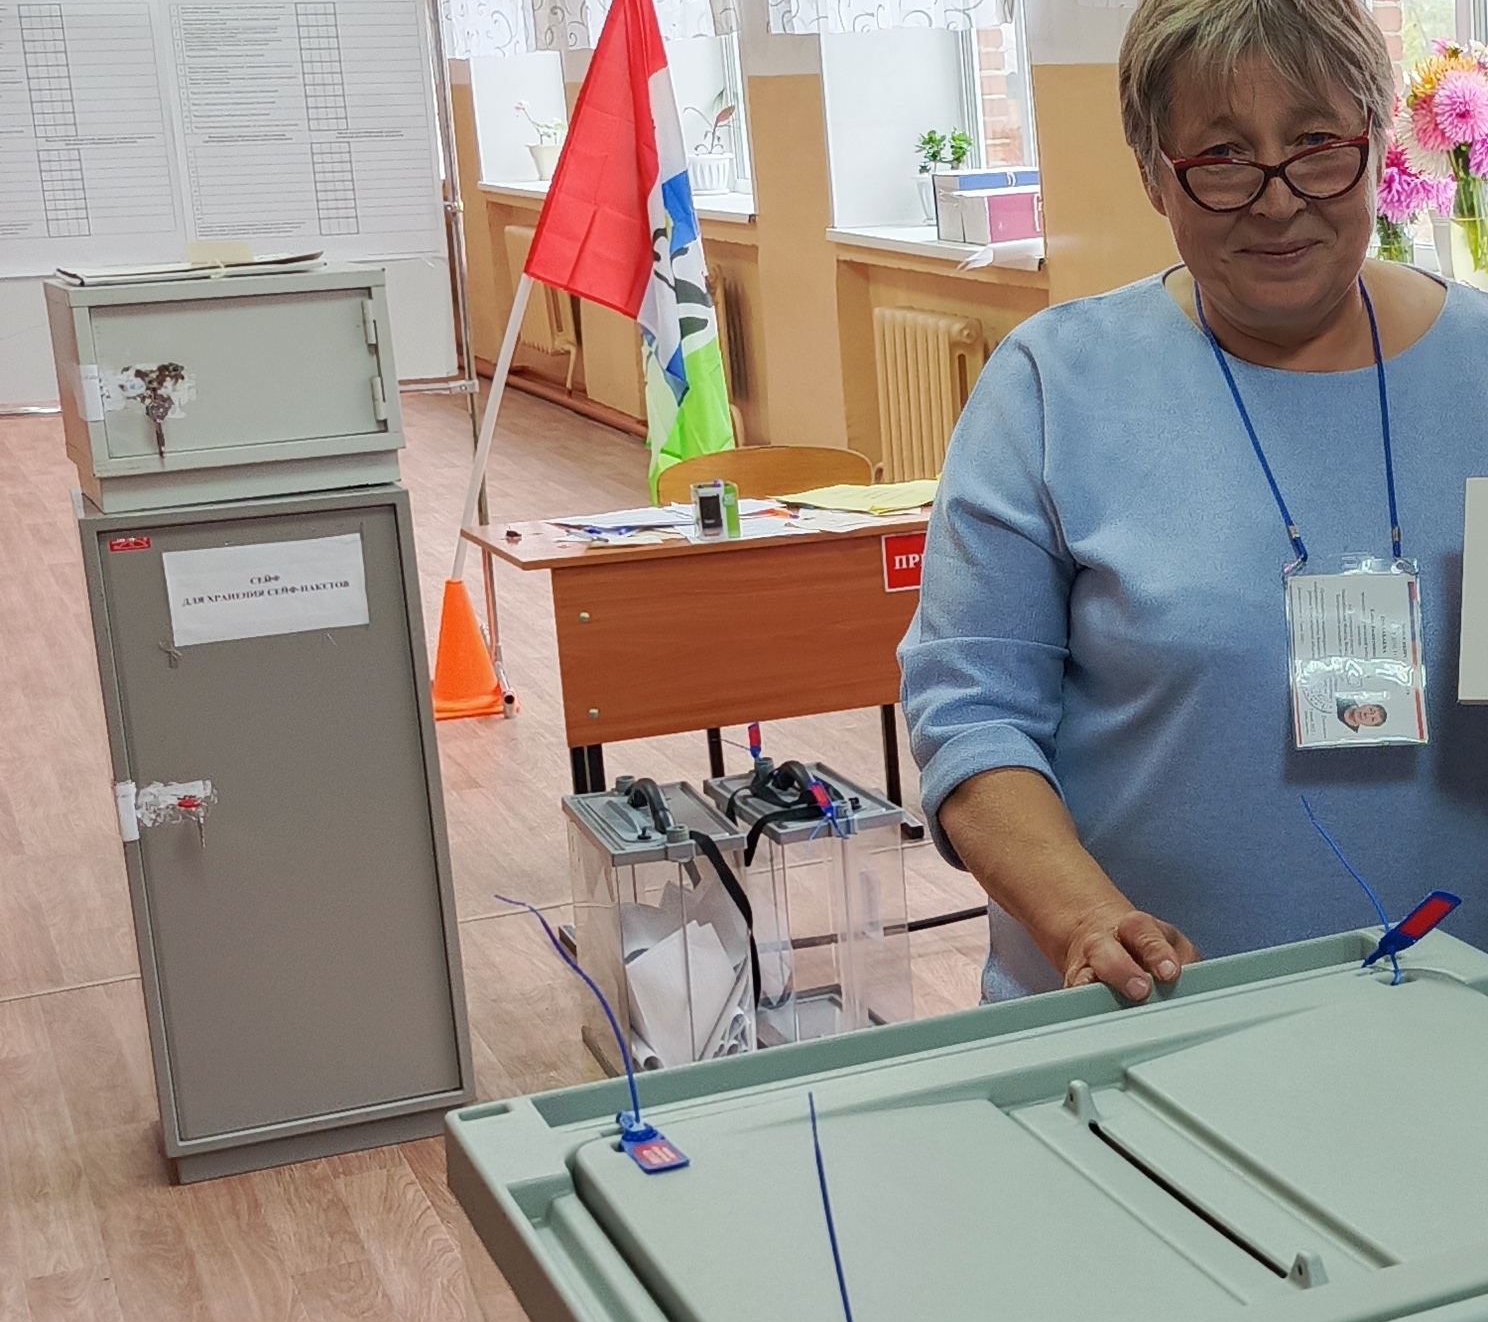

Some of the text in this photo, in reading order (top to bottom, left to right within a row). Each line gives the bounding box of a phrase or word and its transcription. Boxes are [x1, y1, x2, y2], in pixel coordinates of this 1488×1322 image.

[249, 574, 281, 585] СЕЙФ
[182, 596, 205, 607] ДЛЯ
[206, 588, 266, 603] ХРАНЕНИЯ
